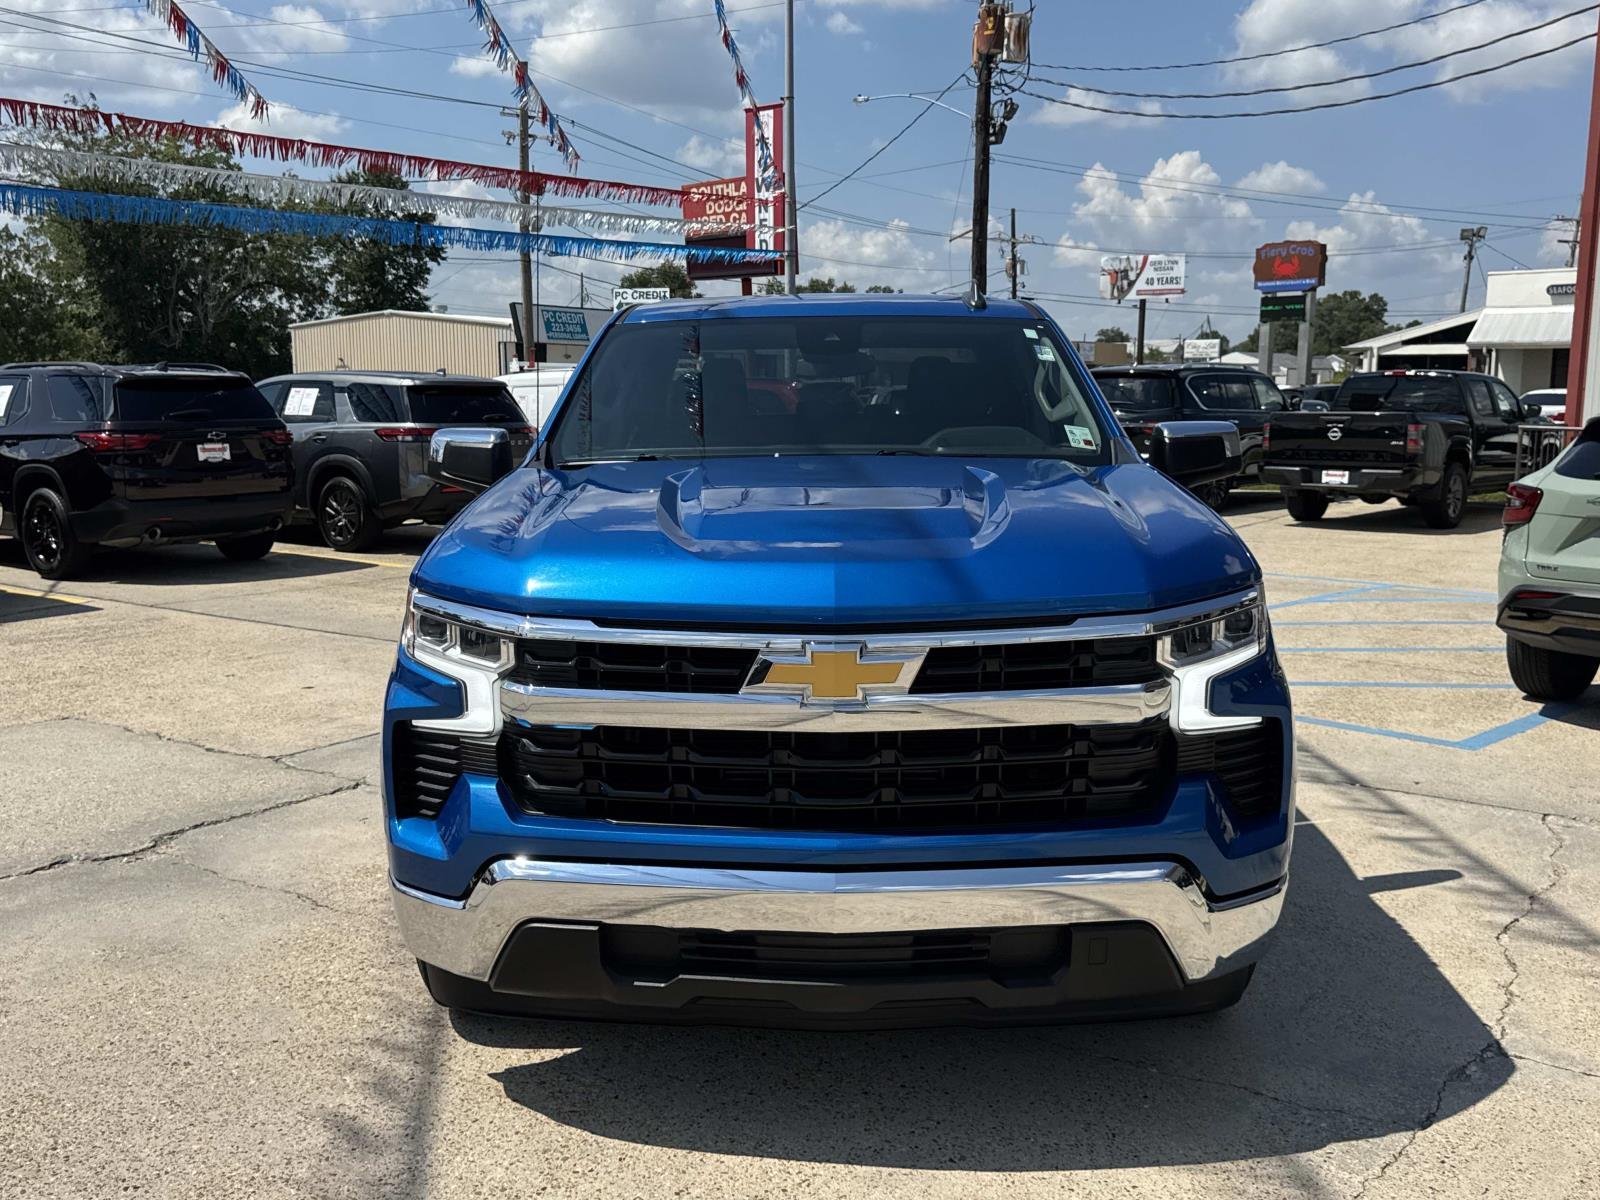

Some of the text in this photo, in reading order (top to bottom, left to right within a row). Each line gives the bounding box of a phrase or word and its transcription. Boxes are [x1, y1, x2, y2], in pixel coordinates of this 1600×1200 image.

[1289, 244, 1314, 256] Crab
[1145, 276, 1182, 286] 40 YEARS!
[615, 289, 669, 300] PC CREDIT
[543, 311, 585, 324] PC CREDIT
